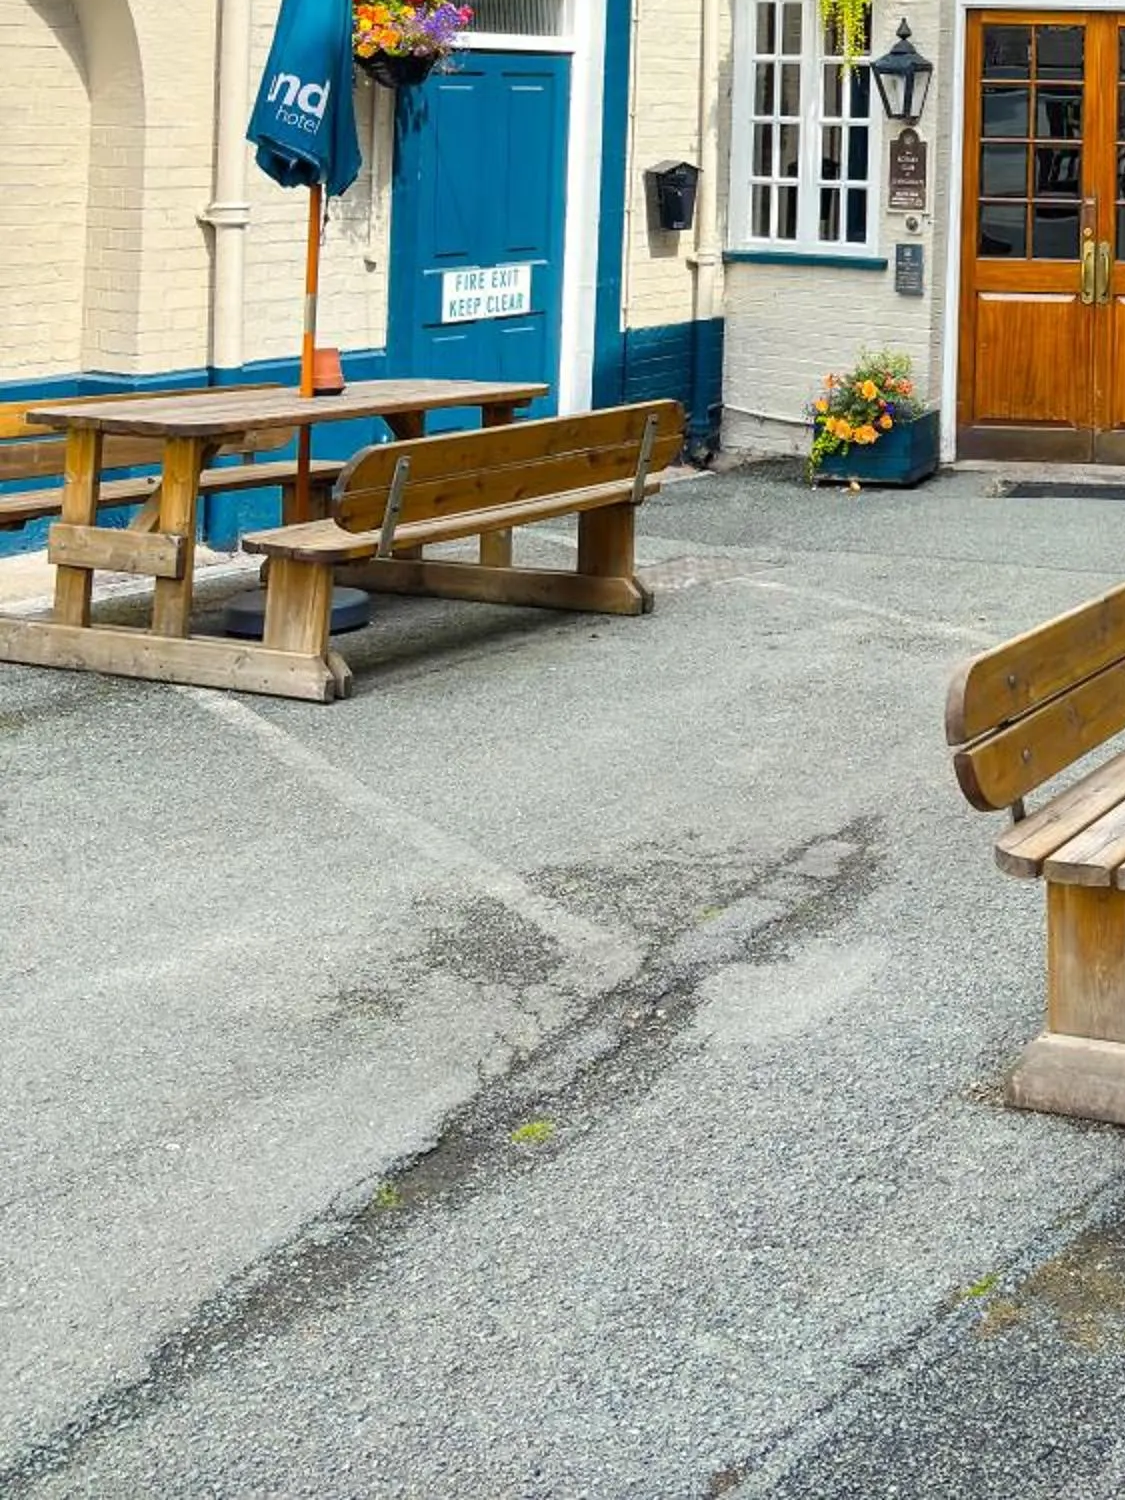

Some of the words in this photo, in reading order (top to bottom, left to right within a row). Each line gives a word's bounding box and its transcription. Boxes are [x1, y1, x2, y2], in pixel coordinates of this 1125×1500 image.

[455, 272, 486, 293] FIRE
[491, 268, 521, 290] EXIT
[449, 297, 481, 318] KEEP
[486, 293, 525, 313] CLEAR
